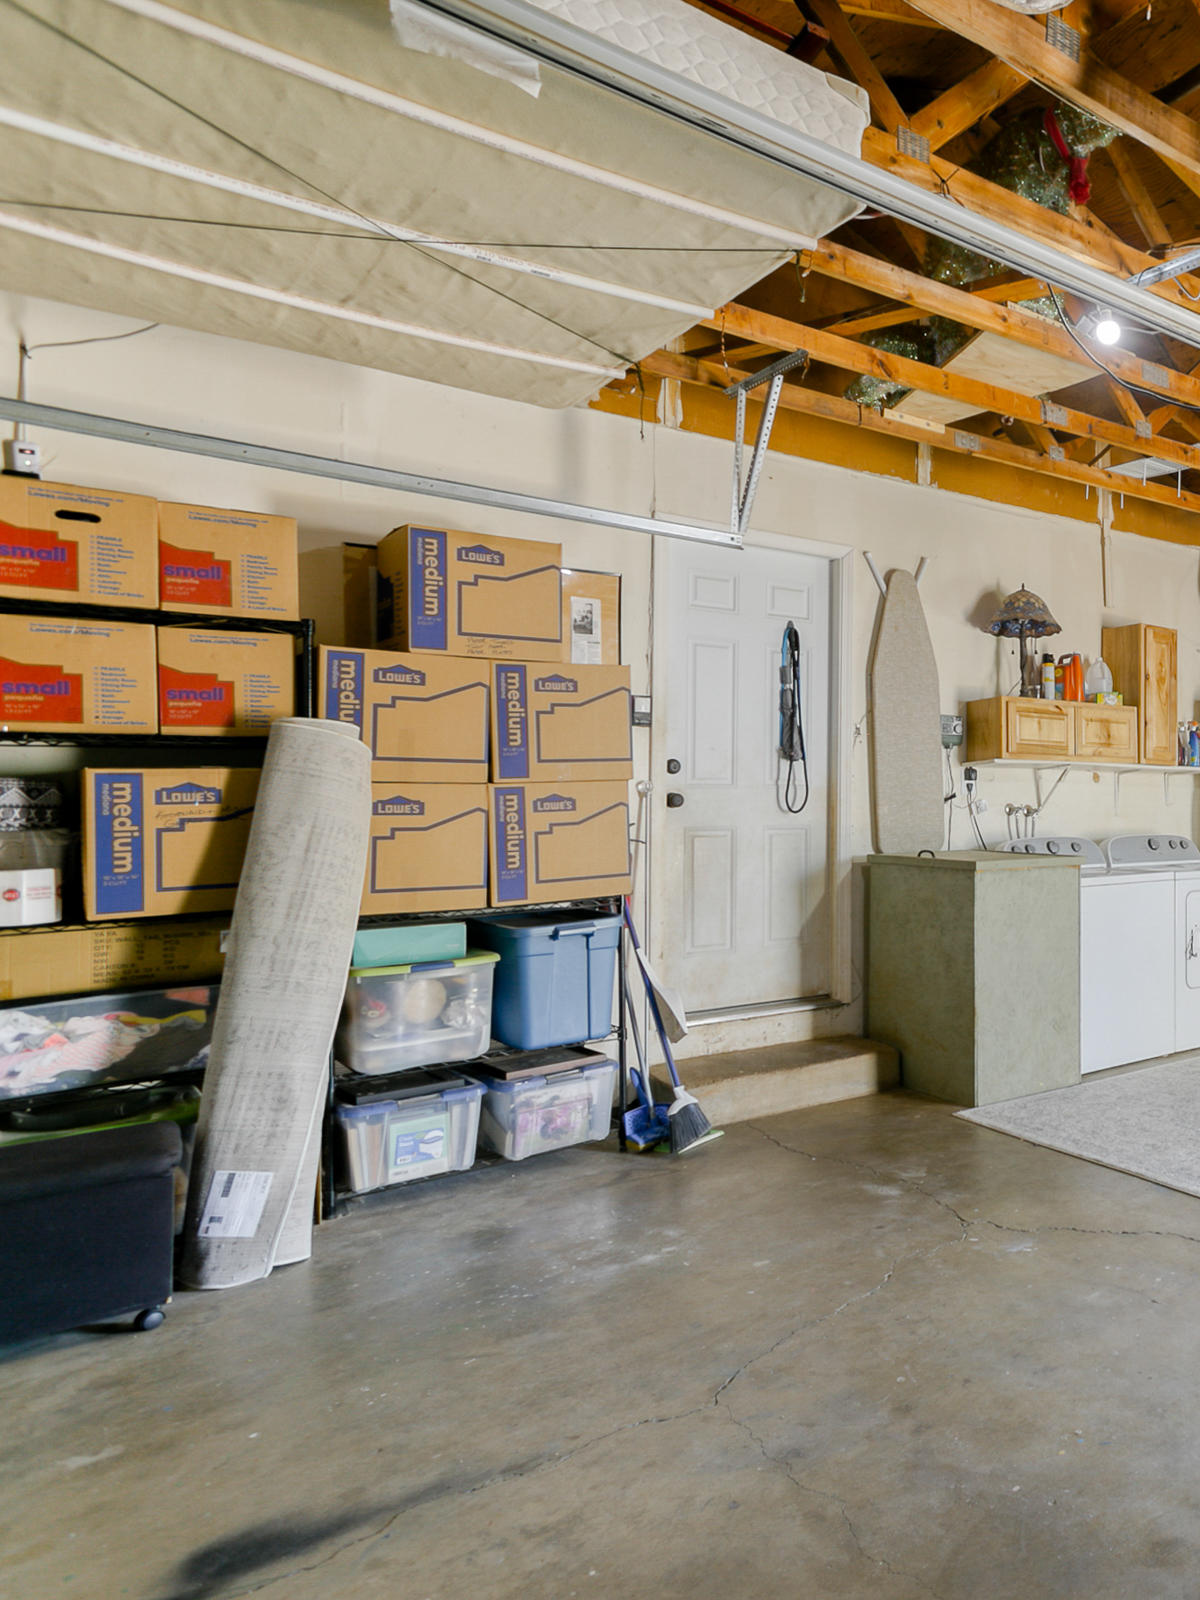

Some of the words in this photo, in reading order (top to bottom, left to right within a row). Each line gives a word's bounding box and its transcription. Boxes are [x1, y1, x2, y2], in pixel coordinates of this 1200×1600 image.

[0, 543, 67, 563] small
[163, 564, 222, 580] small
[424, 537, 443, 616] medium
[2, 680, 71, 696] small
[166, 687, 224, 701] small
[339, 659, 361, 722] mediu
[507, 672, 526, 747] medium
[112, 782, 139, 873] medium
[504, 794, 525, 869] medium
